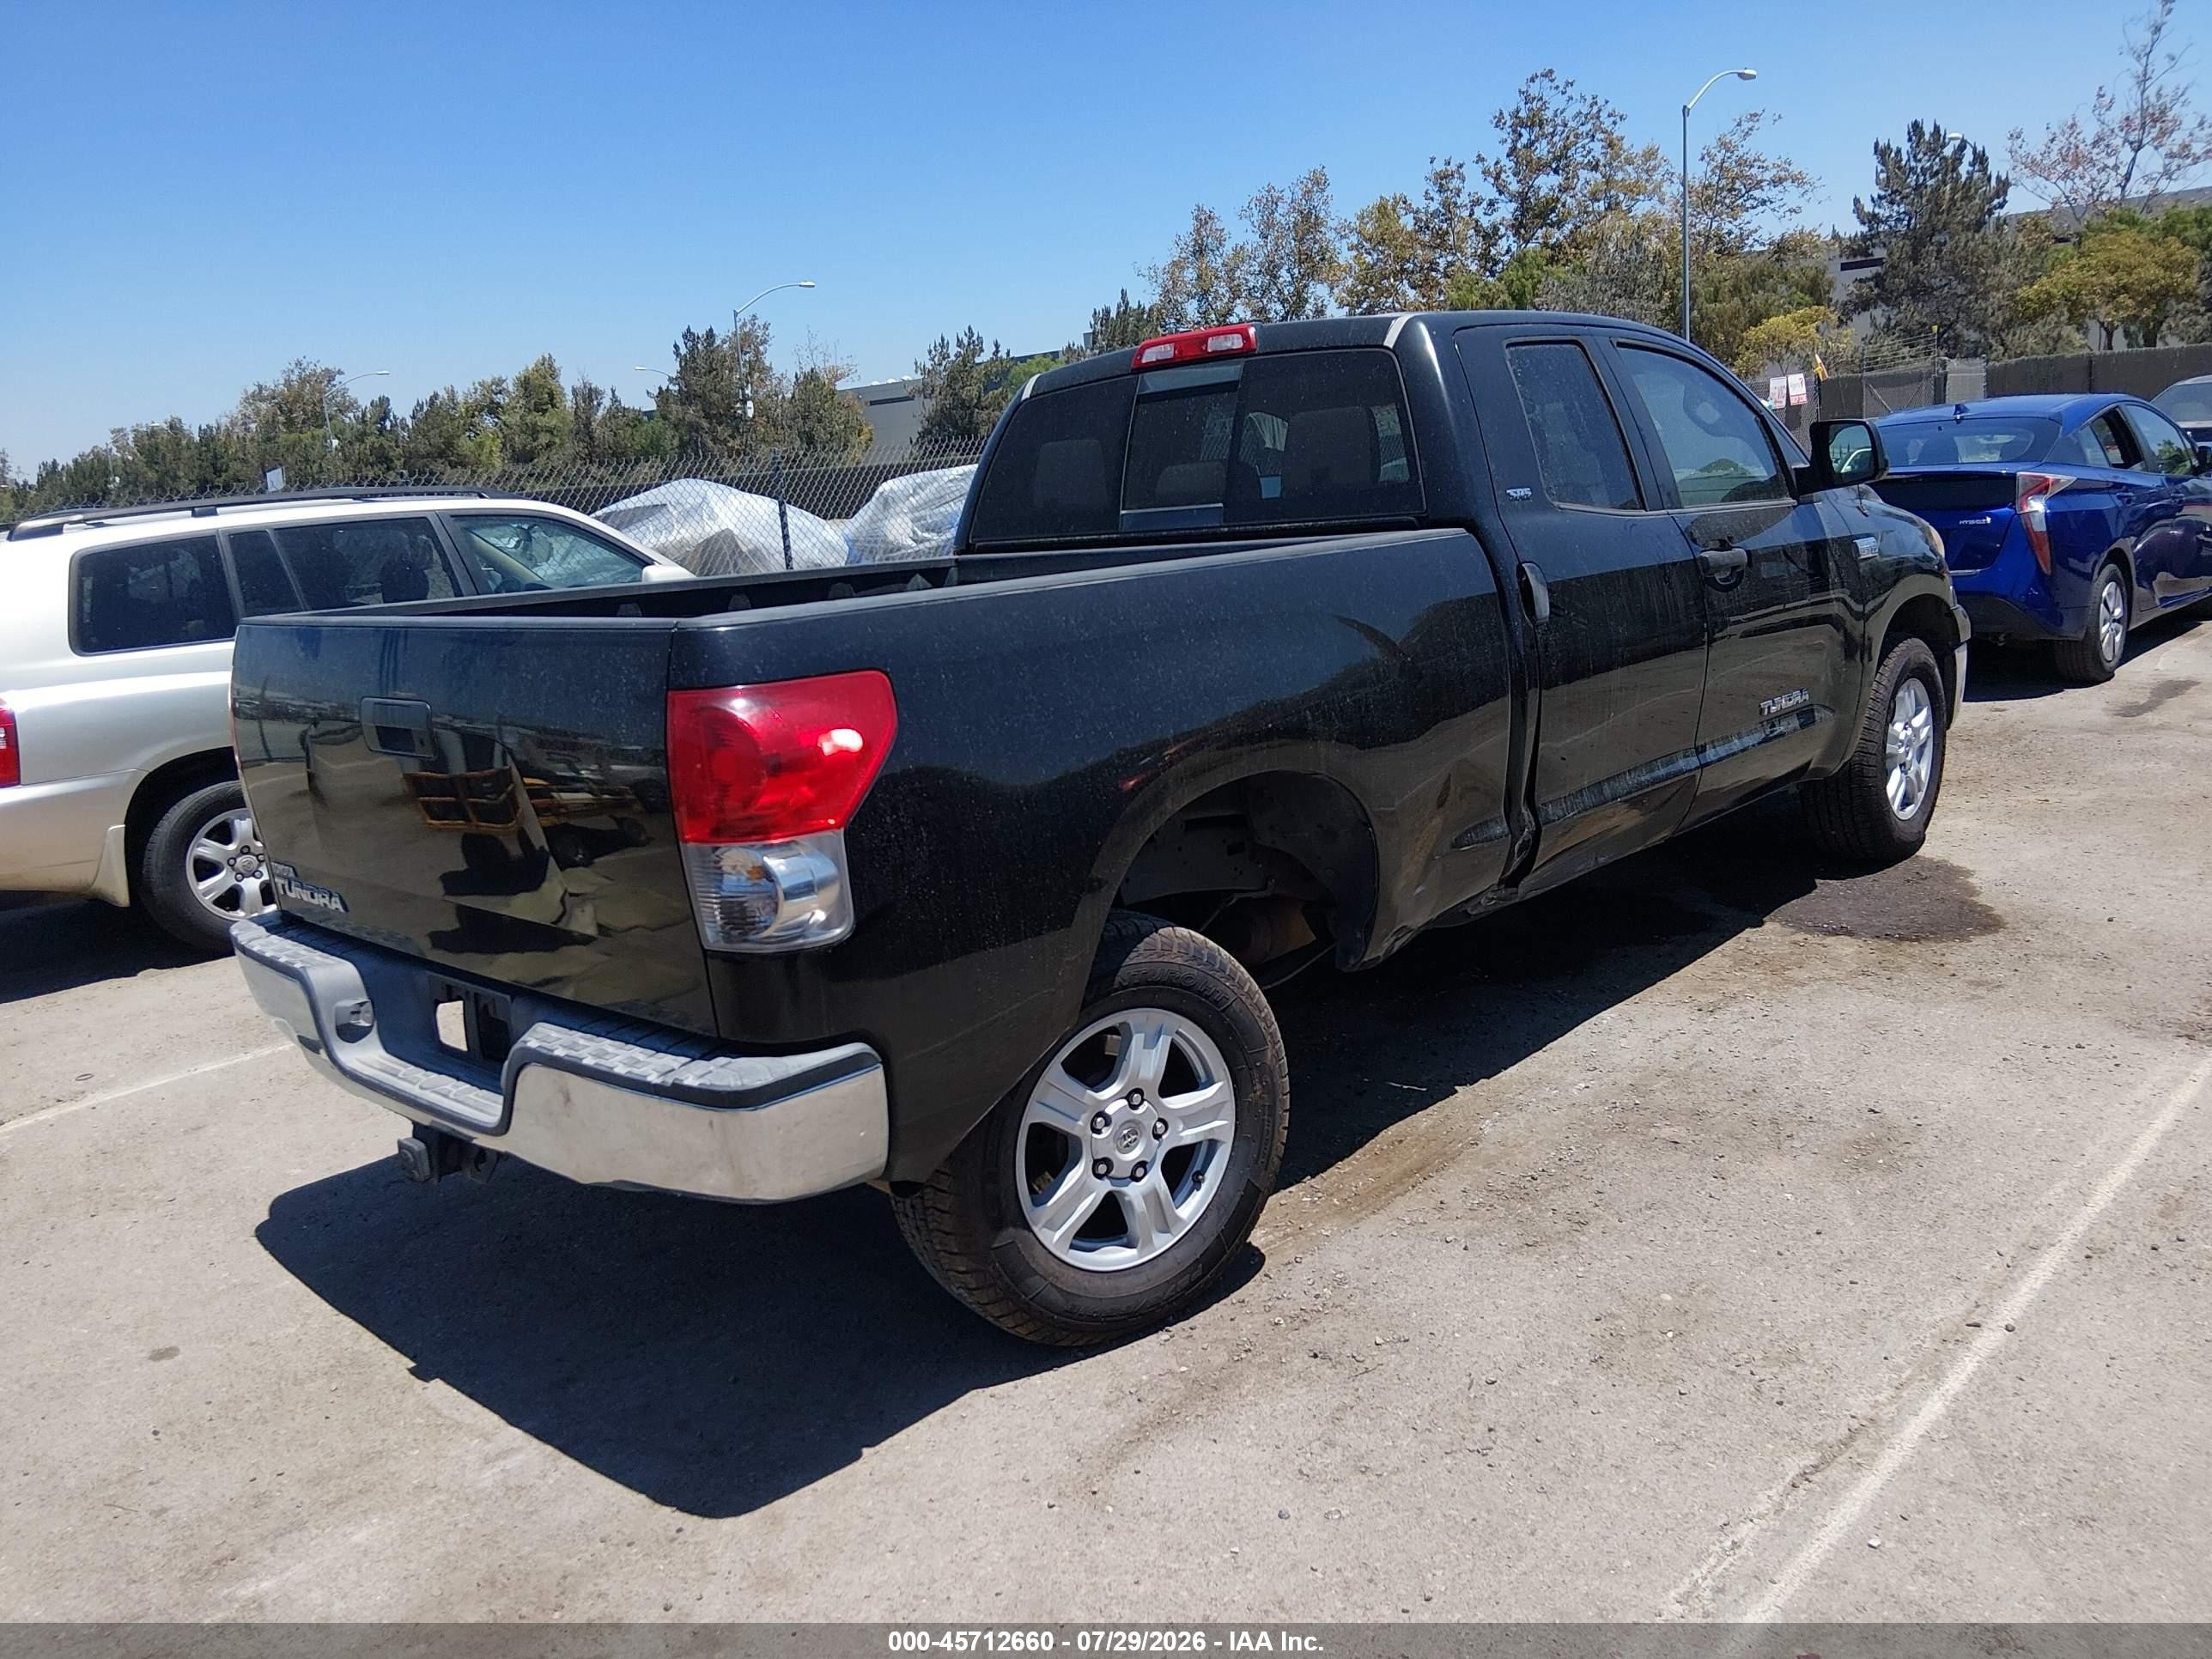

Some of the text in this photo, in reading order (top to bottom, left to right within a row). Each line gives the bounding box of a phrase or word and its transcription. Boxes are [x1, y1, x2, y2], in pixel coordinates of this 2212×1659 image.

[1760, 688, 1809, 716] TUNDRA
[274, 877, 346, 913] TUNDRA
[1112, 967, 1196, 988] NTURO
